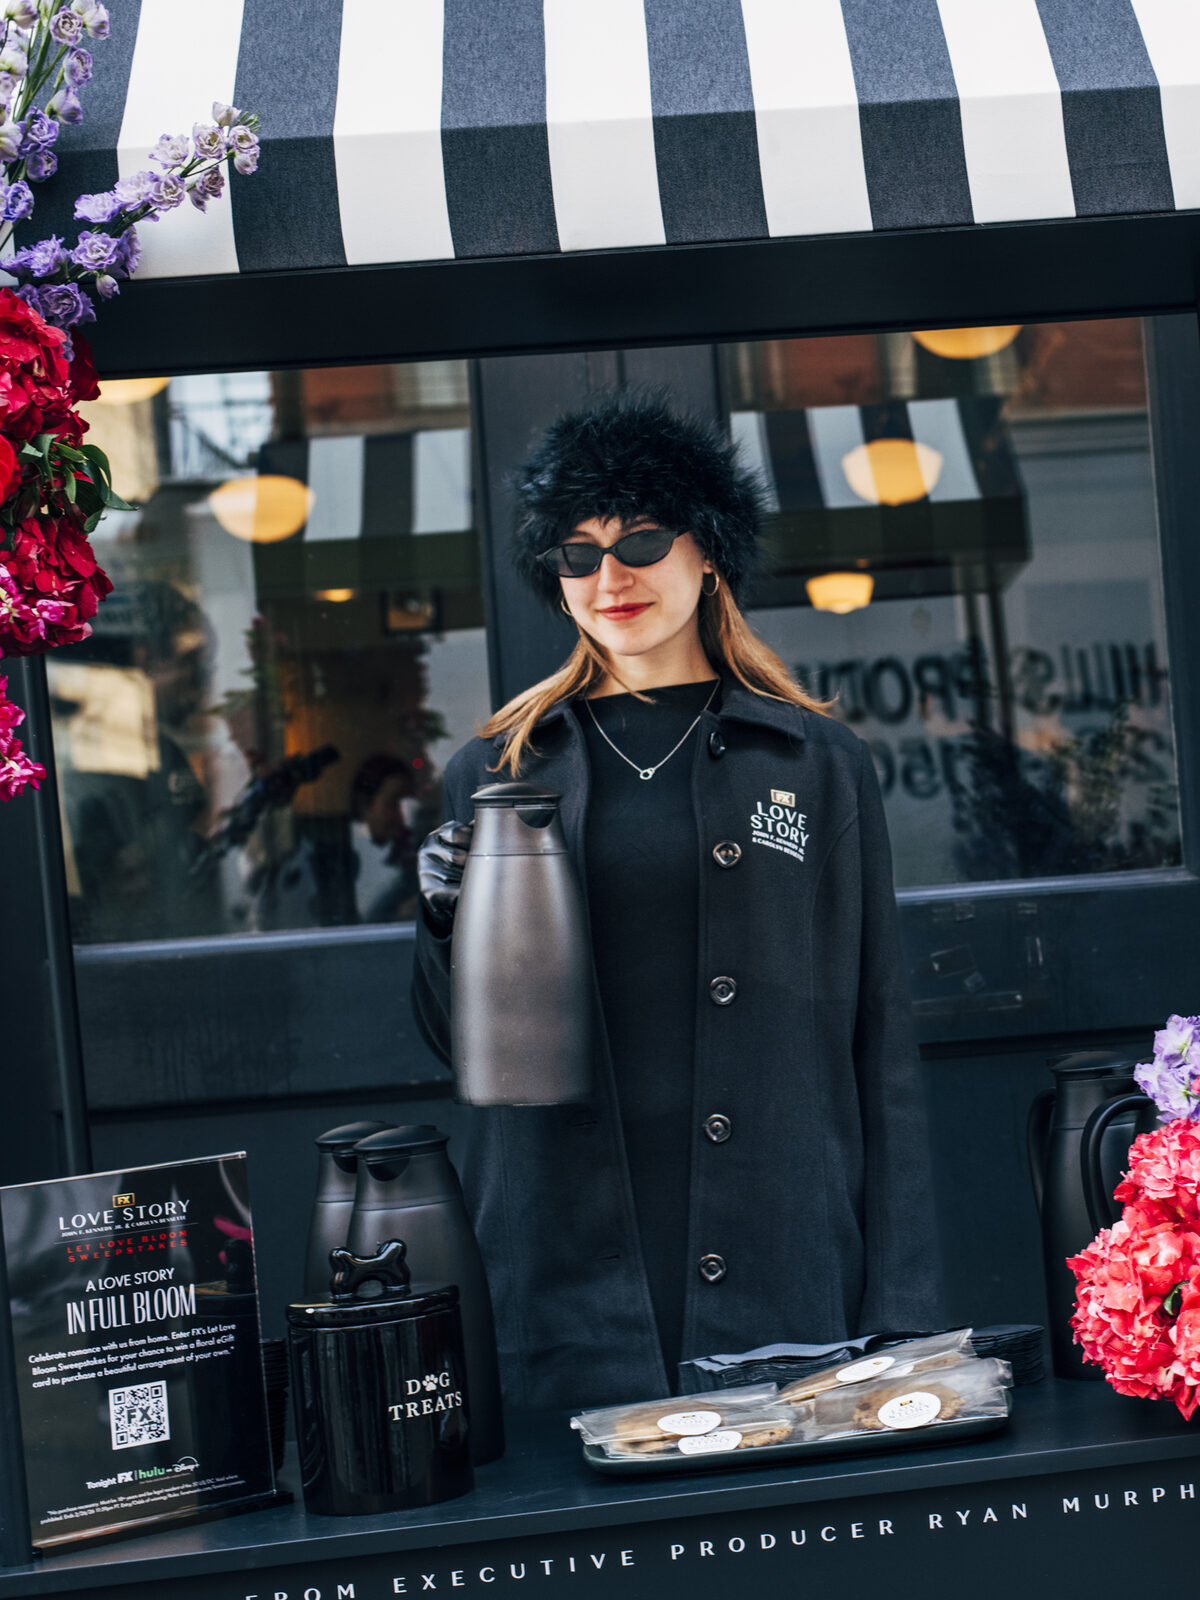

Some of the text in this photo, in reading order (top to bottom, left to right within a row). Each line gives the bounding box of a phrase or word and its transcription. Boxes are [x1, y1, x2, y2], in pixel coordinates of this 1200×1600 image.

[750, 814, 809, 847] STORY
[756, 801, 807, 830] LOVE
[58, 1199, 191, 1231] LOVE STORY
[67, 1230, 187, 1254] LET LOVE BLOOM
[68, 1239, 188, 1263] SWEEPSTAKES
[85, 1267, 175, 1293] A LOVE STORY
[66, 1283, 197, 1335] IN FULL BLOOM
[28, 1322, 236, 1364] Celebrate romance with us from home. Enter FX's Let Love
[31, 1364, 57, 1376] Bloom
[58, 1357, 106, 1373] Sweepstakes
[107, 1353, 119, 1364] for
[119, 1352, 137, 1364] your
[138, 1346, 165, 1359] chance
[166, 1345, 174, 1353] to
[174, 1342, 189, 1352] win
[196, 1336, 215, 1348] floral
[216, 1334, 235, 1345] eGift
[32, 1377, 50, 1389] card
[52, 1375, 60, 1385] to
[61, 1370, 96, 1386] purchase
[104, 1363, 137, 1376] beautiful
[137, 1355, 185, 1371] arrangement
[185, 1352, 194, 1363] of
[194, 1350, 212, 1364] your
[127, 1407, 152, 1424] FX
[388, 1391, 462, 1421] TREATS
[86, 1477, 117, 1490] Tonight
[117, 1470, 134, 1484] FX
[138, 1466, 165, 1479] hulu
[393, 1549, 635, 1594] EXECUTIVE
[670, 1519, 895, 1560] PRODUCER
[929, 1502, 1028, 1530] RYAN
